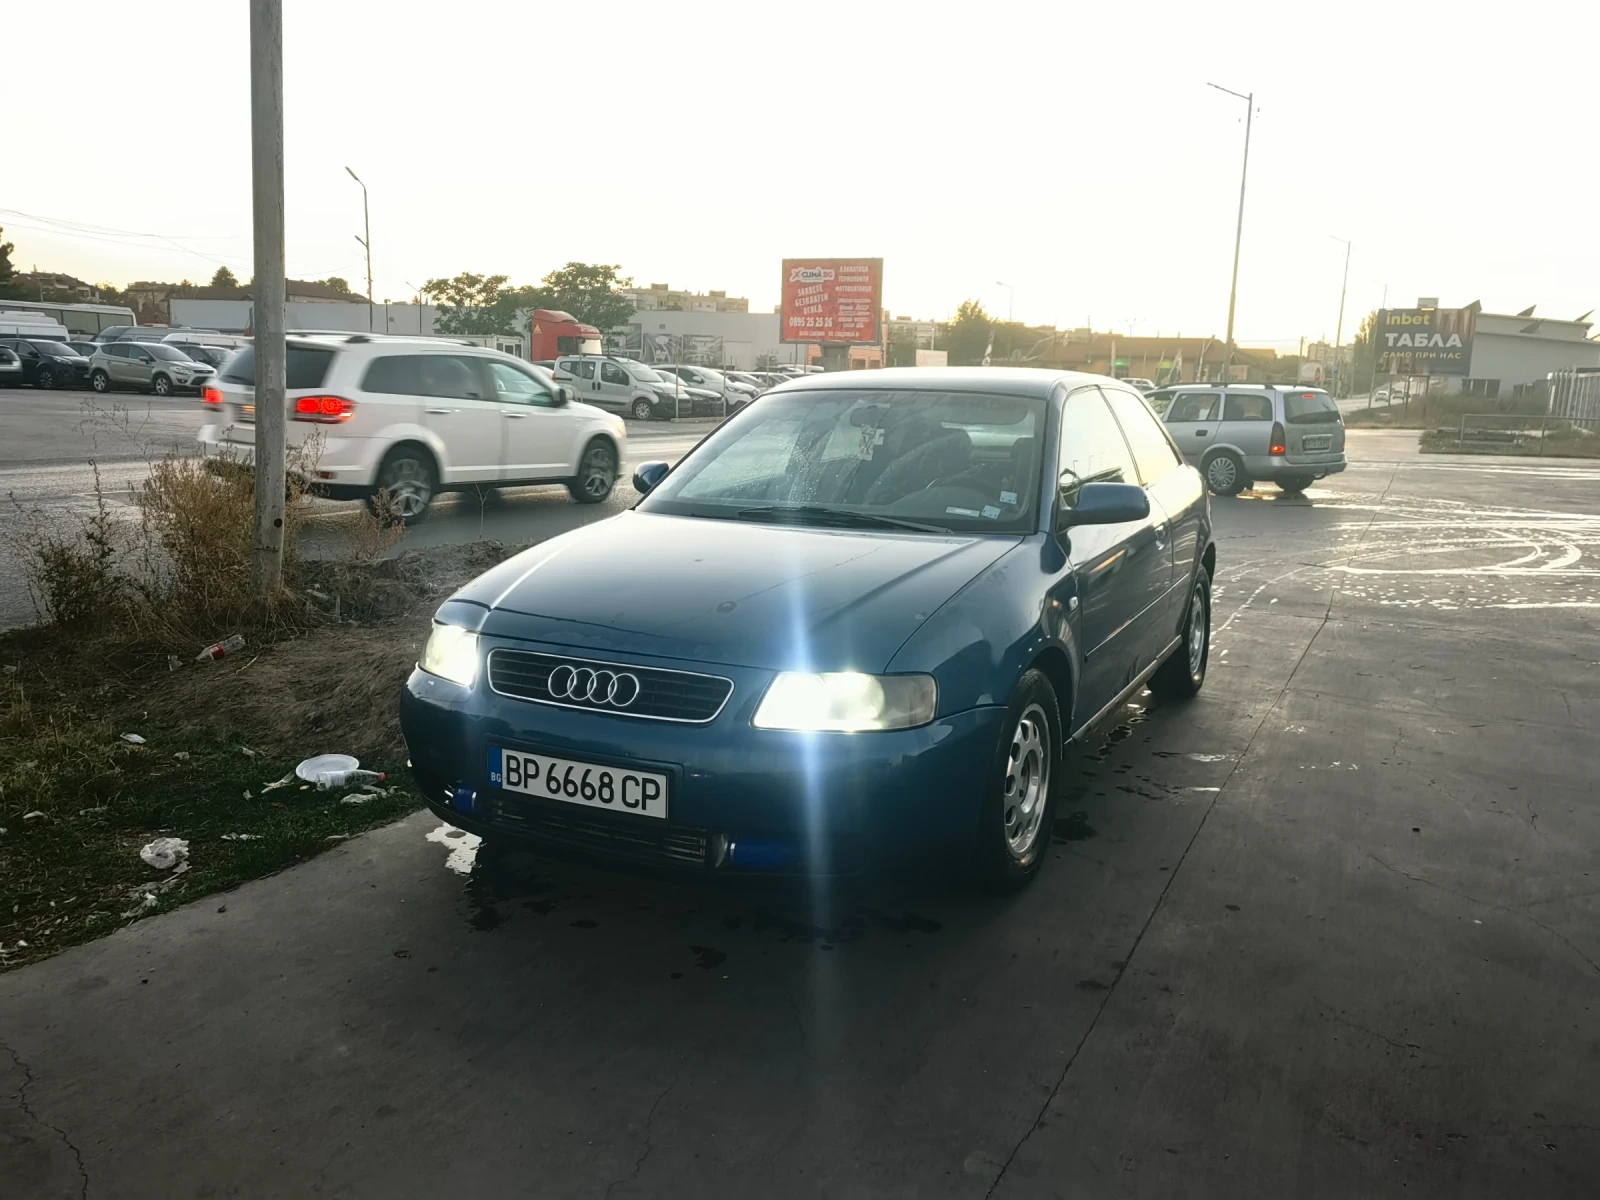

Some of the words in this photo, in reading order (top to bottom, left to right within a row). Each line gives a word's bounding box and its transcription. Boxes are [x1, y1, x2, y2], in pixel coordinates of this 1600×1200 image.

[806, 317, 814, 327] 25
[815, 317, 823, 327] 25
[1386, 312, 1430, 325] inbet
[1385, 333, 1462, 347] ТАБЛА
[490, 772, 501, 783] BG
[505, 754, 540, 789] BP
[545, 762, 614, 804] 6668
[621, 774, 661, 811] CP
